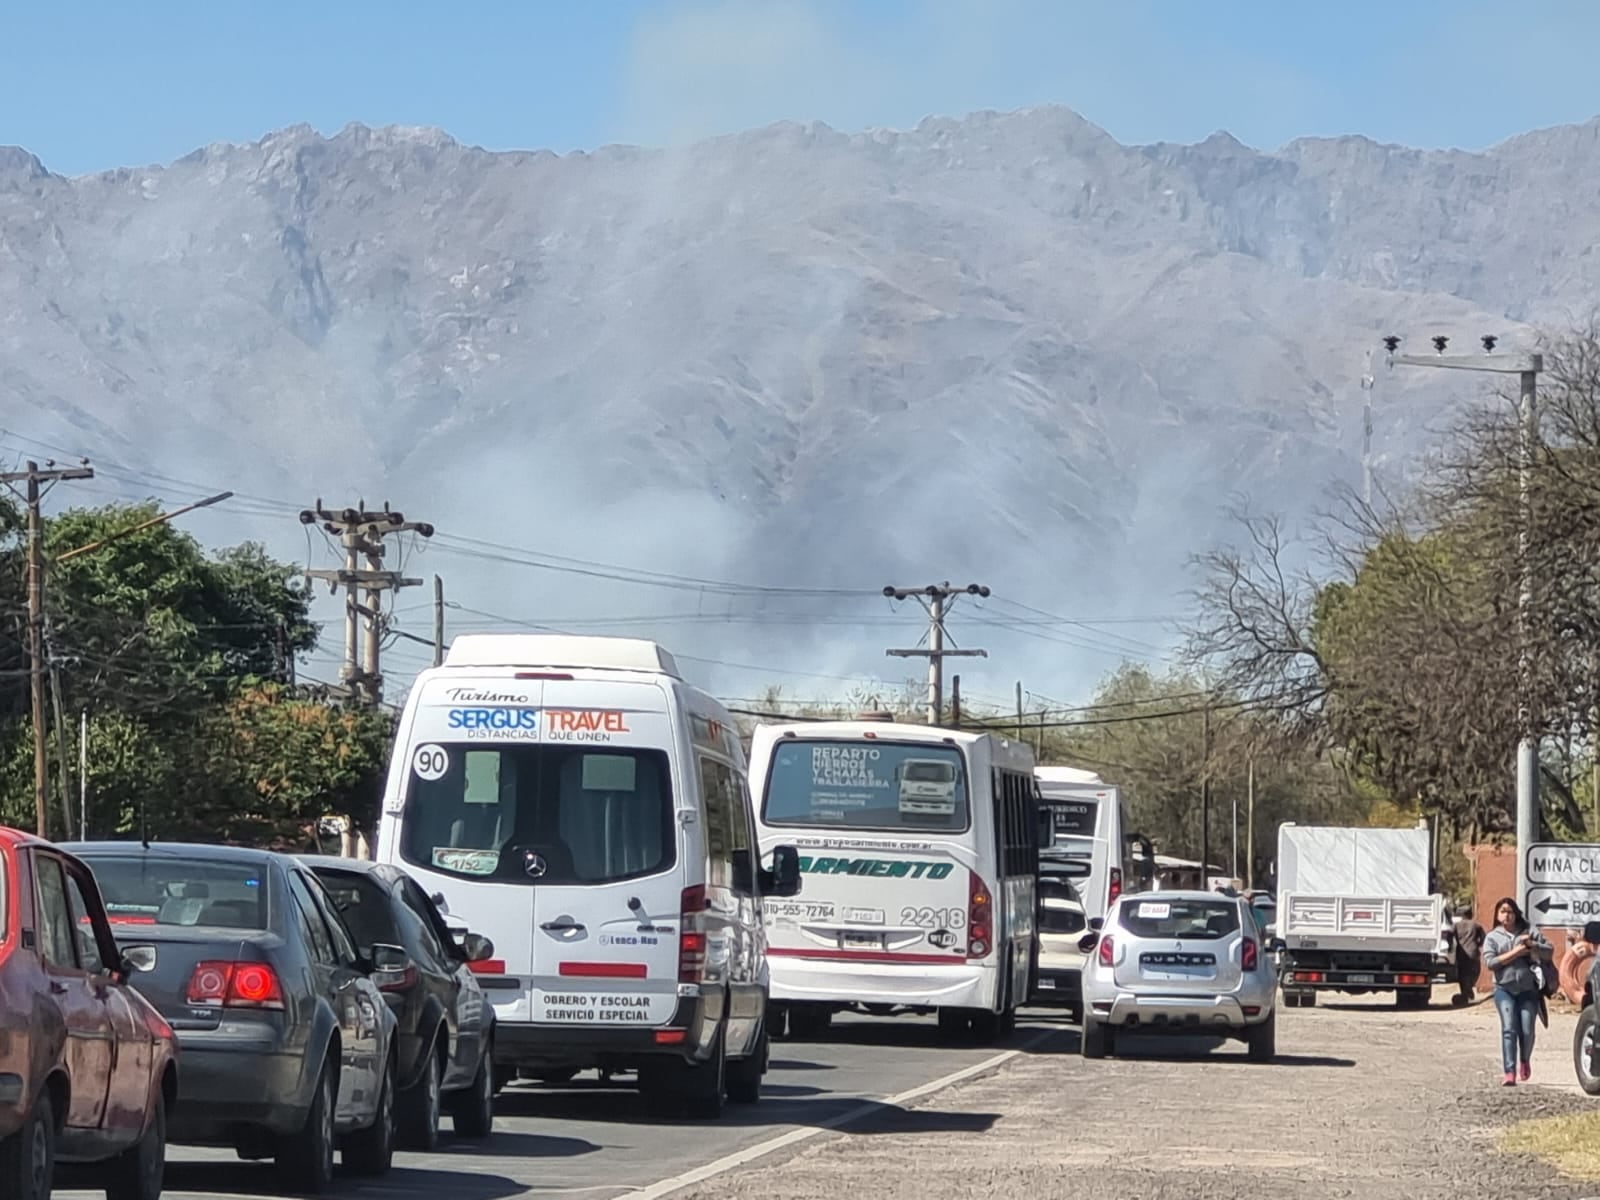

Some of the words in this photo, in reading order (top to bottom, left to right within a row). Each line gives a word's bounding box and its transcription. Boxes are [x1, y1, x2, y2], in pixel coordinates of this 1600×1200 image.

[446, 687, 529, 703] Turismo
[448, 709, 536, 729] SERGUS
[545, 710, 630, 732] TRAVEL
[467, 729, 538, 740] DISTANCIAS
[548, 731, 574, 741] QUE
[577, 732, 611, 742] UNEN
[812, 747, 880, 760] REPARTO
[419, 751, 445, 773] 90
[812, 768, 819, 777] Y
[824, 768, 874, 778] CHAPAS
[768, 856, 954, 879] ARMIENTO
[1534, 858, 1572, 873] MINA
[900, 906, 965, 929] 2218
[543, 995, 587, 1006] OBRERO
[591, 996, 598, 1006] Y
[600, 996, 650, 1007] ESCOLAR
[546, 1009, 594, 1020] SERVICIO
[600, 1010, 649, 1021] ESPECIAL
